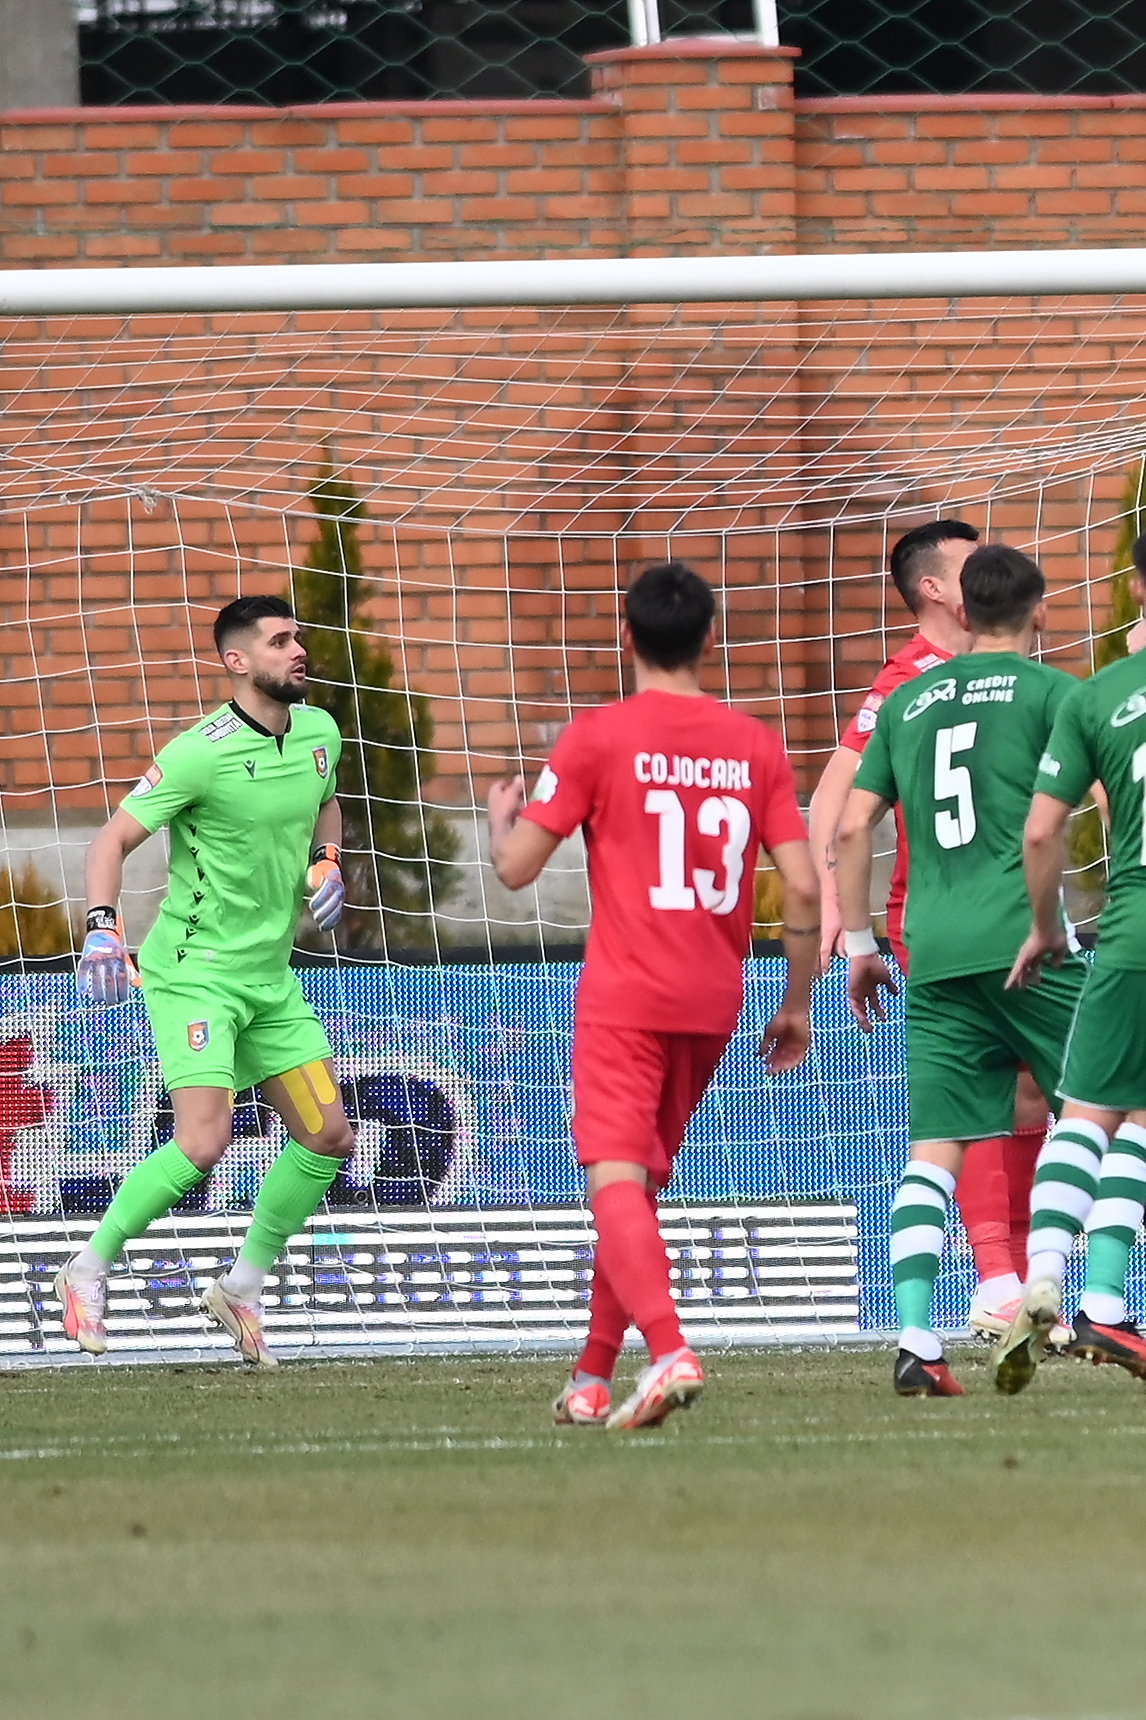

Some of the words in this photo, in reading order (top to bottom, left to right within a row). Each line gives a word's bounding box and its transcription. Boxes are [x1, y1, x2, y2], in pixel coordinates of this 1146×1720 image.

[961, 689, 1014, 706] ONLINE
[966, 675, 1018, 692] CREDIT
[933, 721, 978, 850] 5
[643, 788, 751, 916] 13
